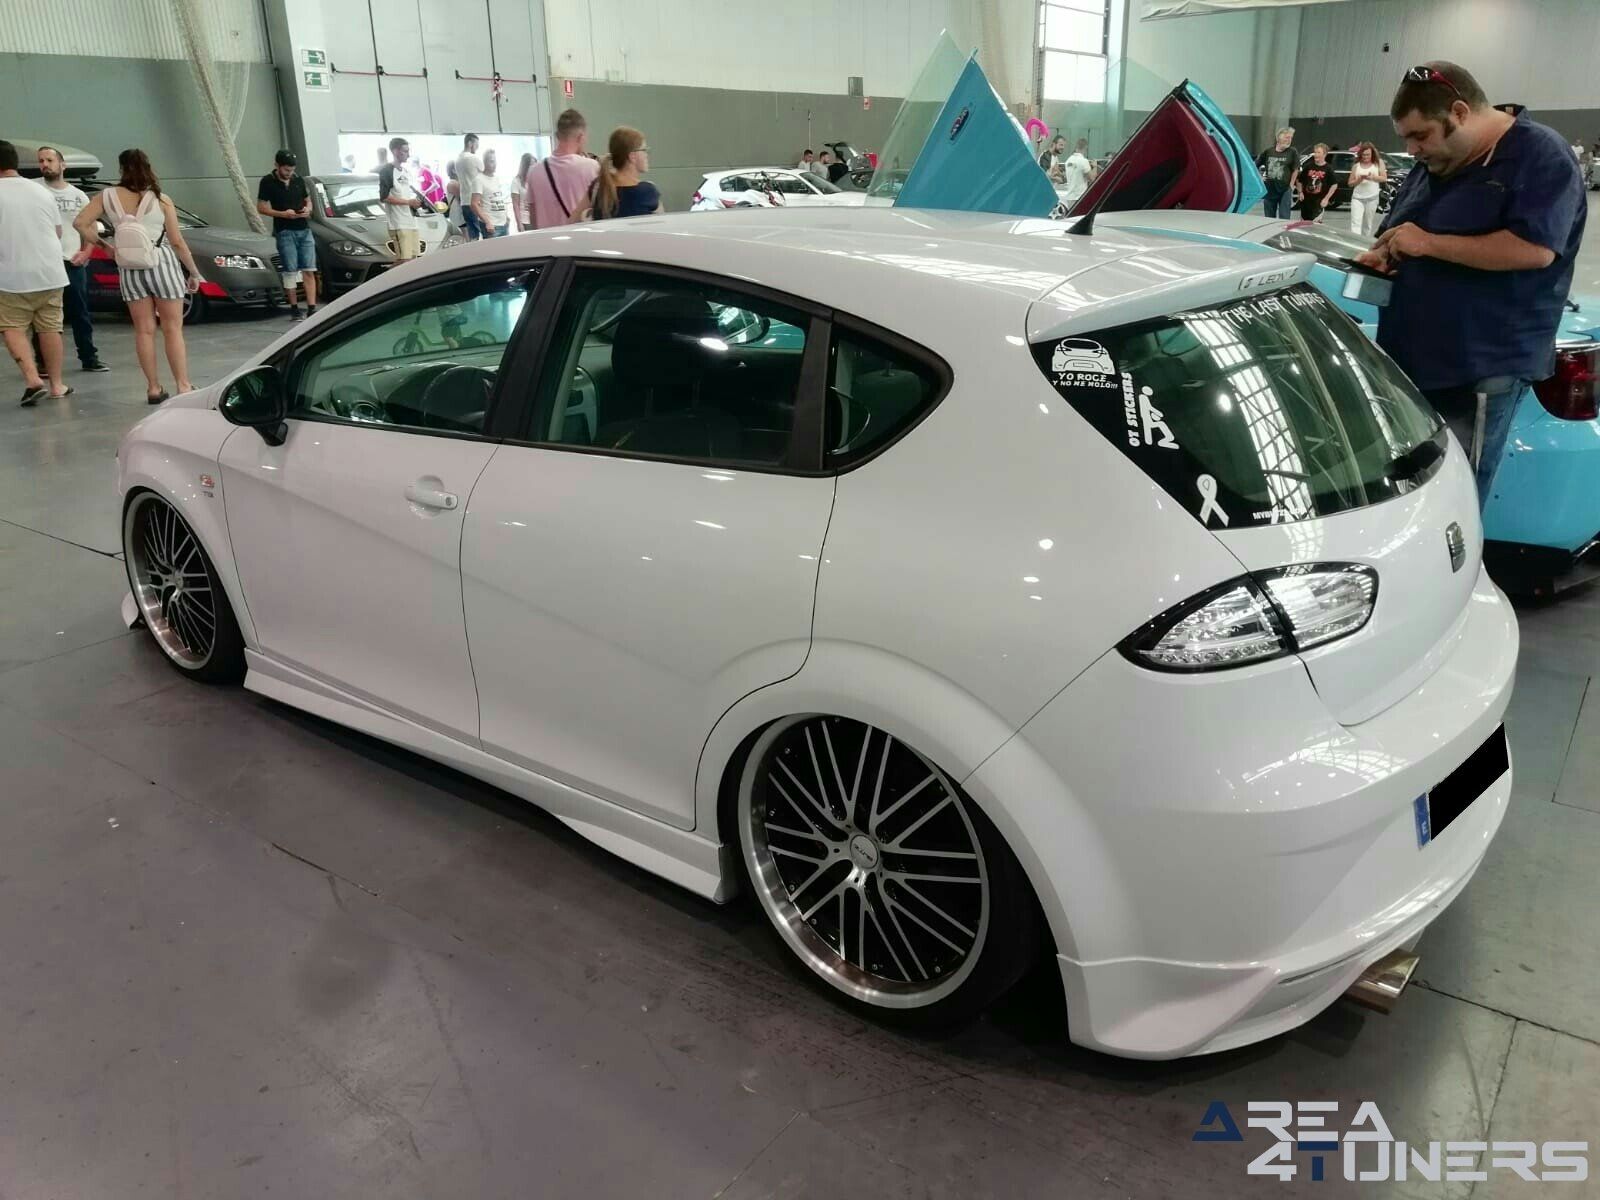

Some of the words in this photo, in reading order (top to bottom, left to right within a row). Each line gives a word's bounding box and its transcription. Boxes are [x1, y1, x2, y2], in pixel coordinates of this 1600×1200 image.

[1257, 272, 1285, 286] LEON
[1221, 306, 1252, 329] THE
[1250, 297, 1290, 319] LAST
[1058, 372, 1074, 381] YO
[1121, 372, 1138, 427] STICKERS
[1128, 430, 1140, 447] OT
